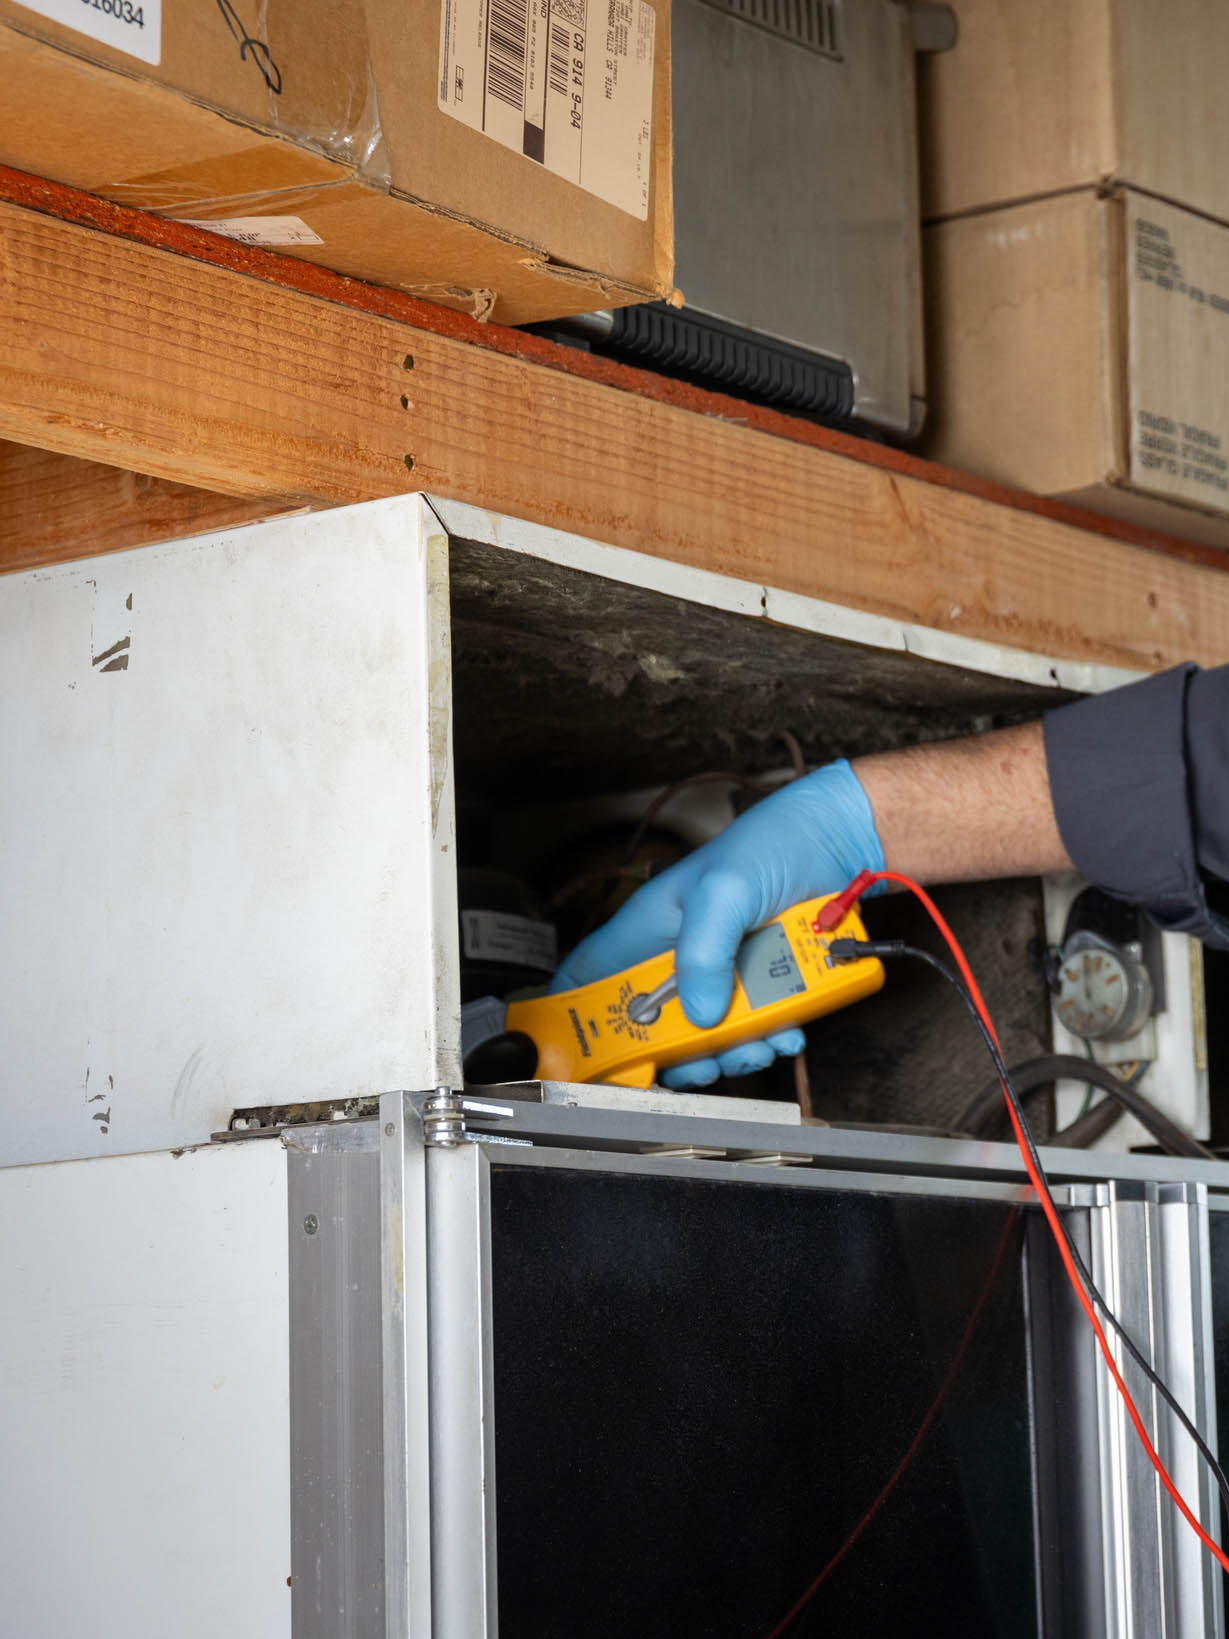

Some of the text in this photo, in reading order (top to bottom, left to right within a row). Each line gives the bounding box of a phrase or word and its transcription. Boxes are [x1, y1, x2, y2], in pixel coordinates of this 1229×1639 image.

[82, 0, 144, 29] 6034
[606, 29, 615, 53] HILLS
[570, 33, 584, 130] CA 914 9-04
